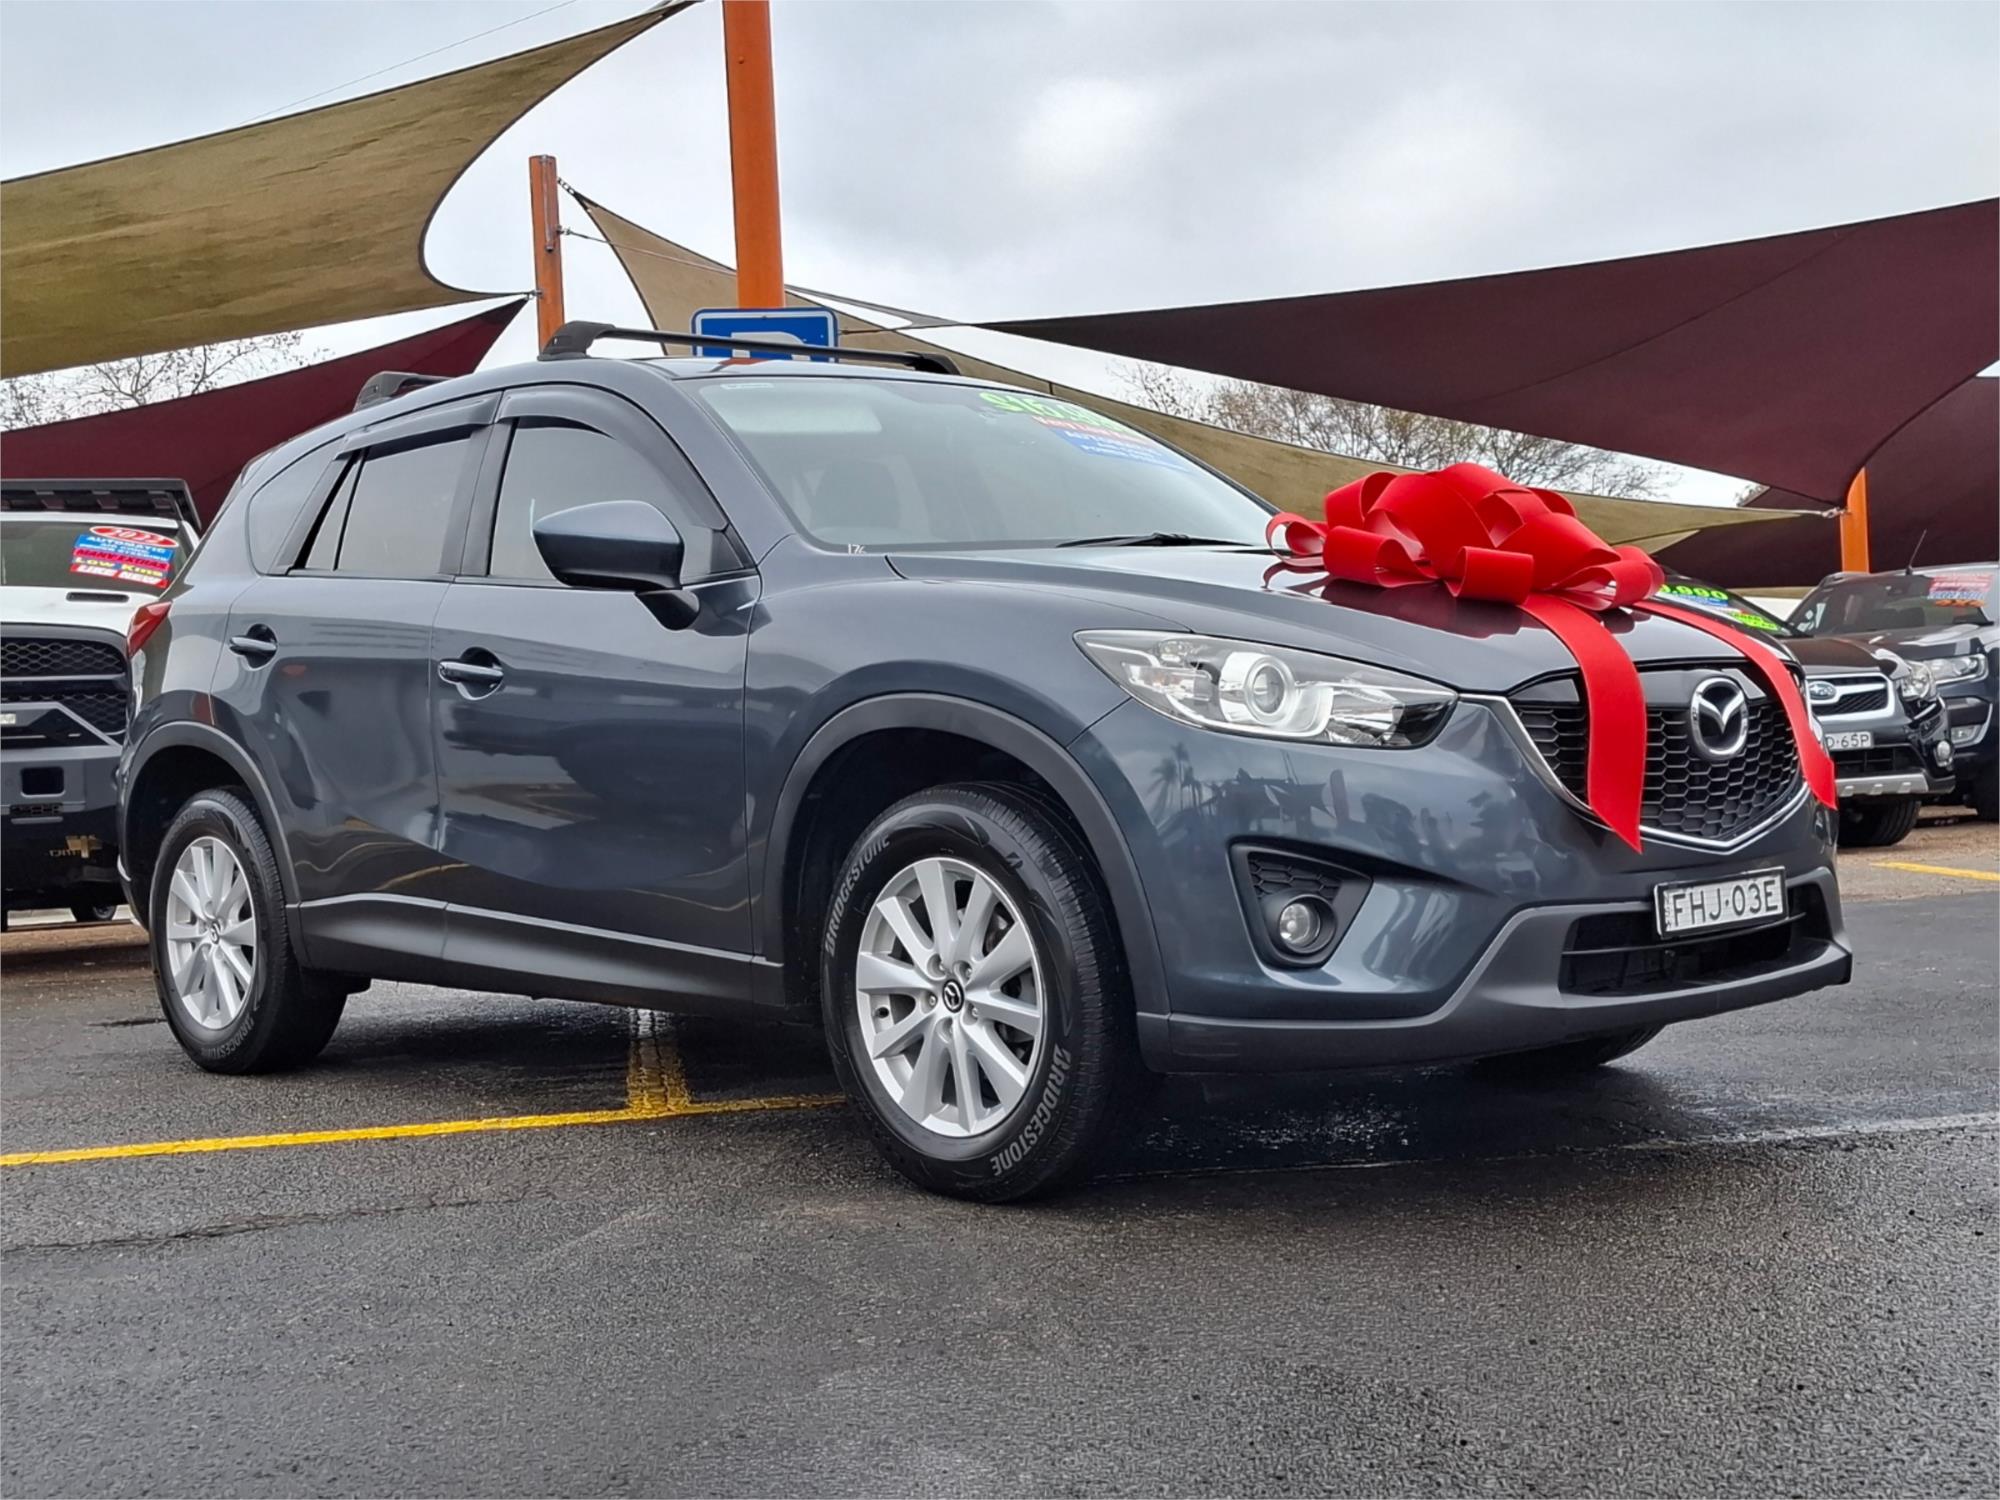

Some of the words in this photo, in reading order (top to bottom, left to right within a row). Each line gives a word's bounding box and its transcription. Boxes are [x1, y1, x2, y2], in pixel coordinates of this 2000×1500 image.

[77, 549, 116, 561] MANY
[86, 536, 167, 553] AUTOMATIC
[77, 564, 118, 577] LIKE
[118, 571, 162, 585] NEW
[824, 835, 890, 957] BRIDGESTONE
[990, 1043, 1071, 1177] BRIDGESTONE
